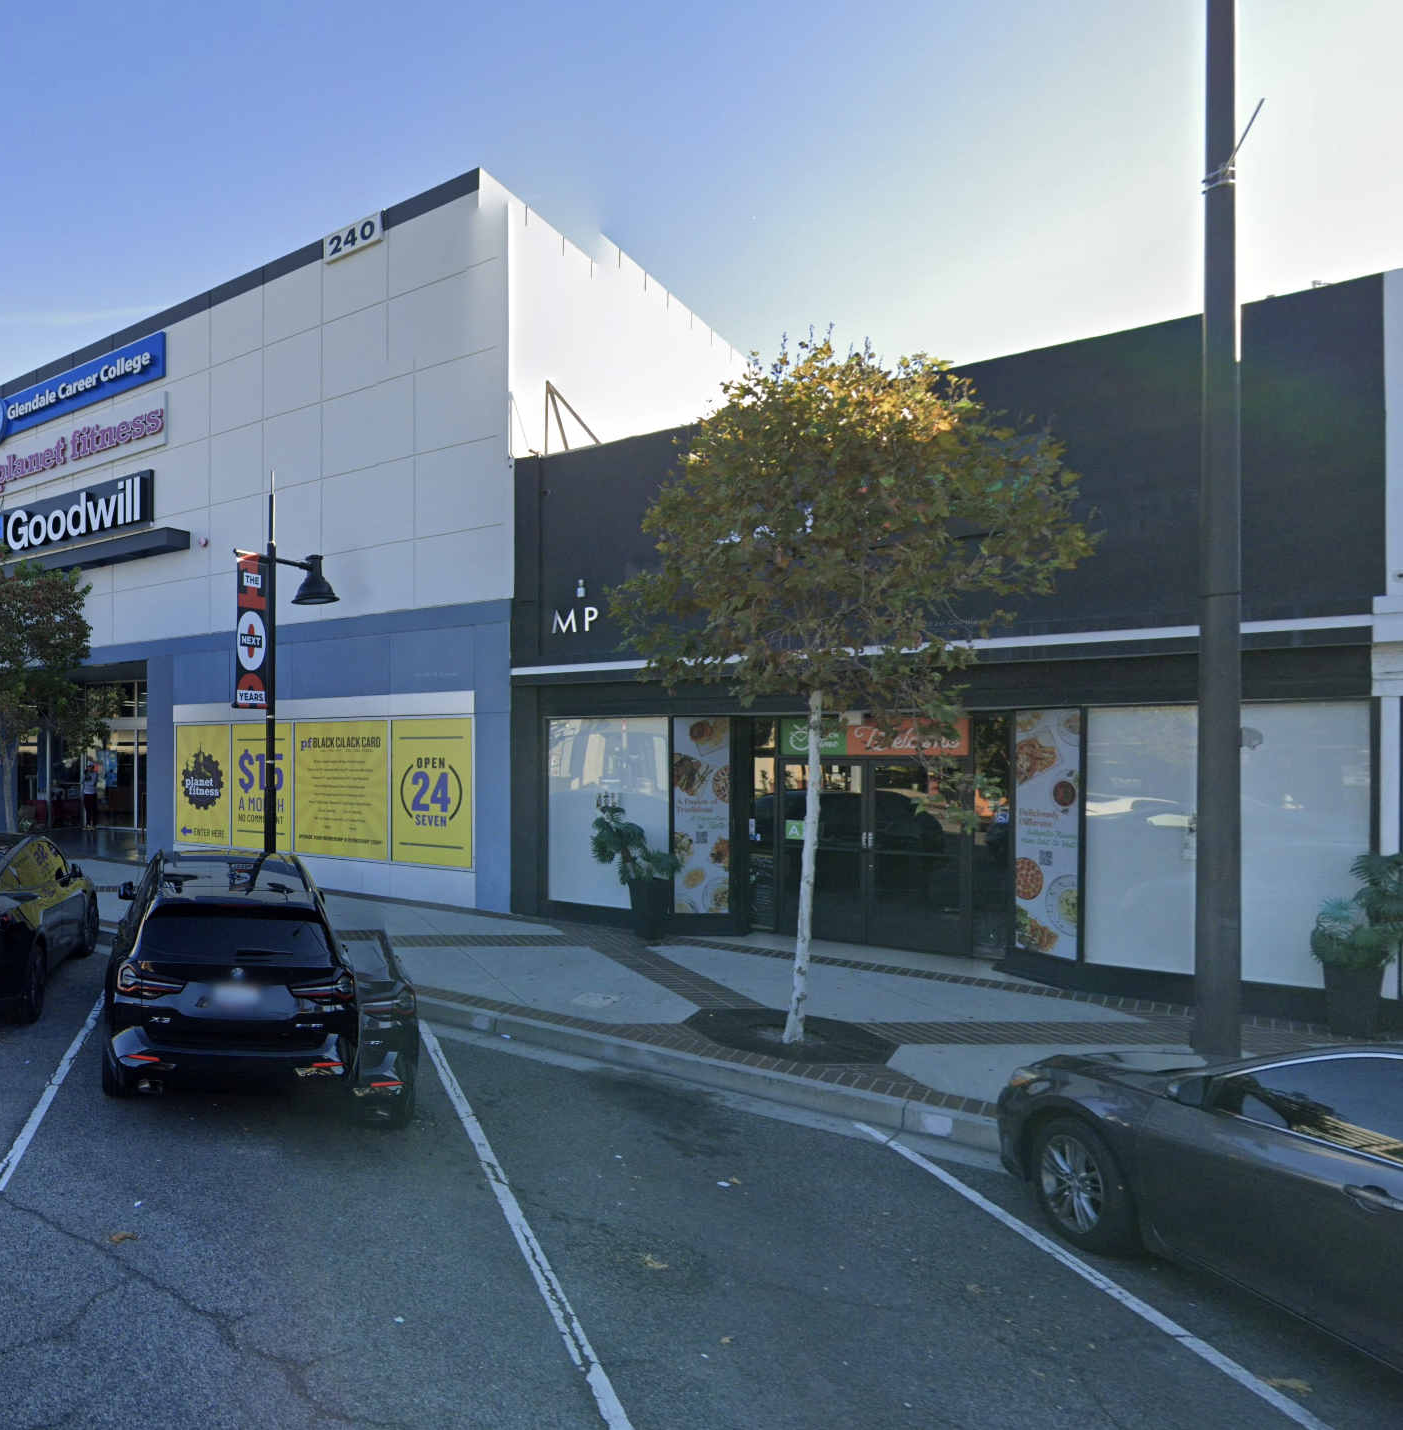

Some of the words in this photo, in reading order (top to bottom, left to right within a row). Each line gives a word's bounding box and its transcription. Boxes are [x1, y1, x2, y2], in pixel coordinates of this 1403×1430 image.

[328, 220, 375, 257] 240
[6, 389, 56, 420] Glendale
[57, 372, 99, 400] Career
[99, 351, 151, 383] College
[69, 408, 165, 461] fitness
[6, 476, 142, 551] Goodwill
[245, 574, 261, 586] THE
[241, 634, 262, 647] NEXT
[239, 691, 264, 702] YEARS
[300, 737, 313, 751] pf
[312, 737, 335, 748] BLACK
[361, 736, 381, 748] CARD
[416, 757, 446, 769] OPEN
[238, 748, 284, 794] $15
[185, 776, 214, 789] planet
[188, 785, 220, 797] fitness
[411, 770, 451, 813] 24
[238, 797, 245, 811] A
[248, 797, 285, 814] MOH
[684, 798, 709, 806] Fusion
[238, 813, 246, 823] NO
[415, 814, 447, 828] SEVEN
[193, 827, 211, 837] ENTER
[211, 828, 225, 839] HERE
[788, 824, 800, 836] A
[149, 1015, 172, 1024] X3
